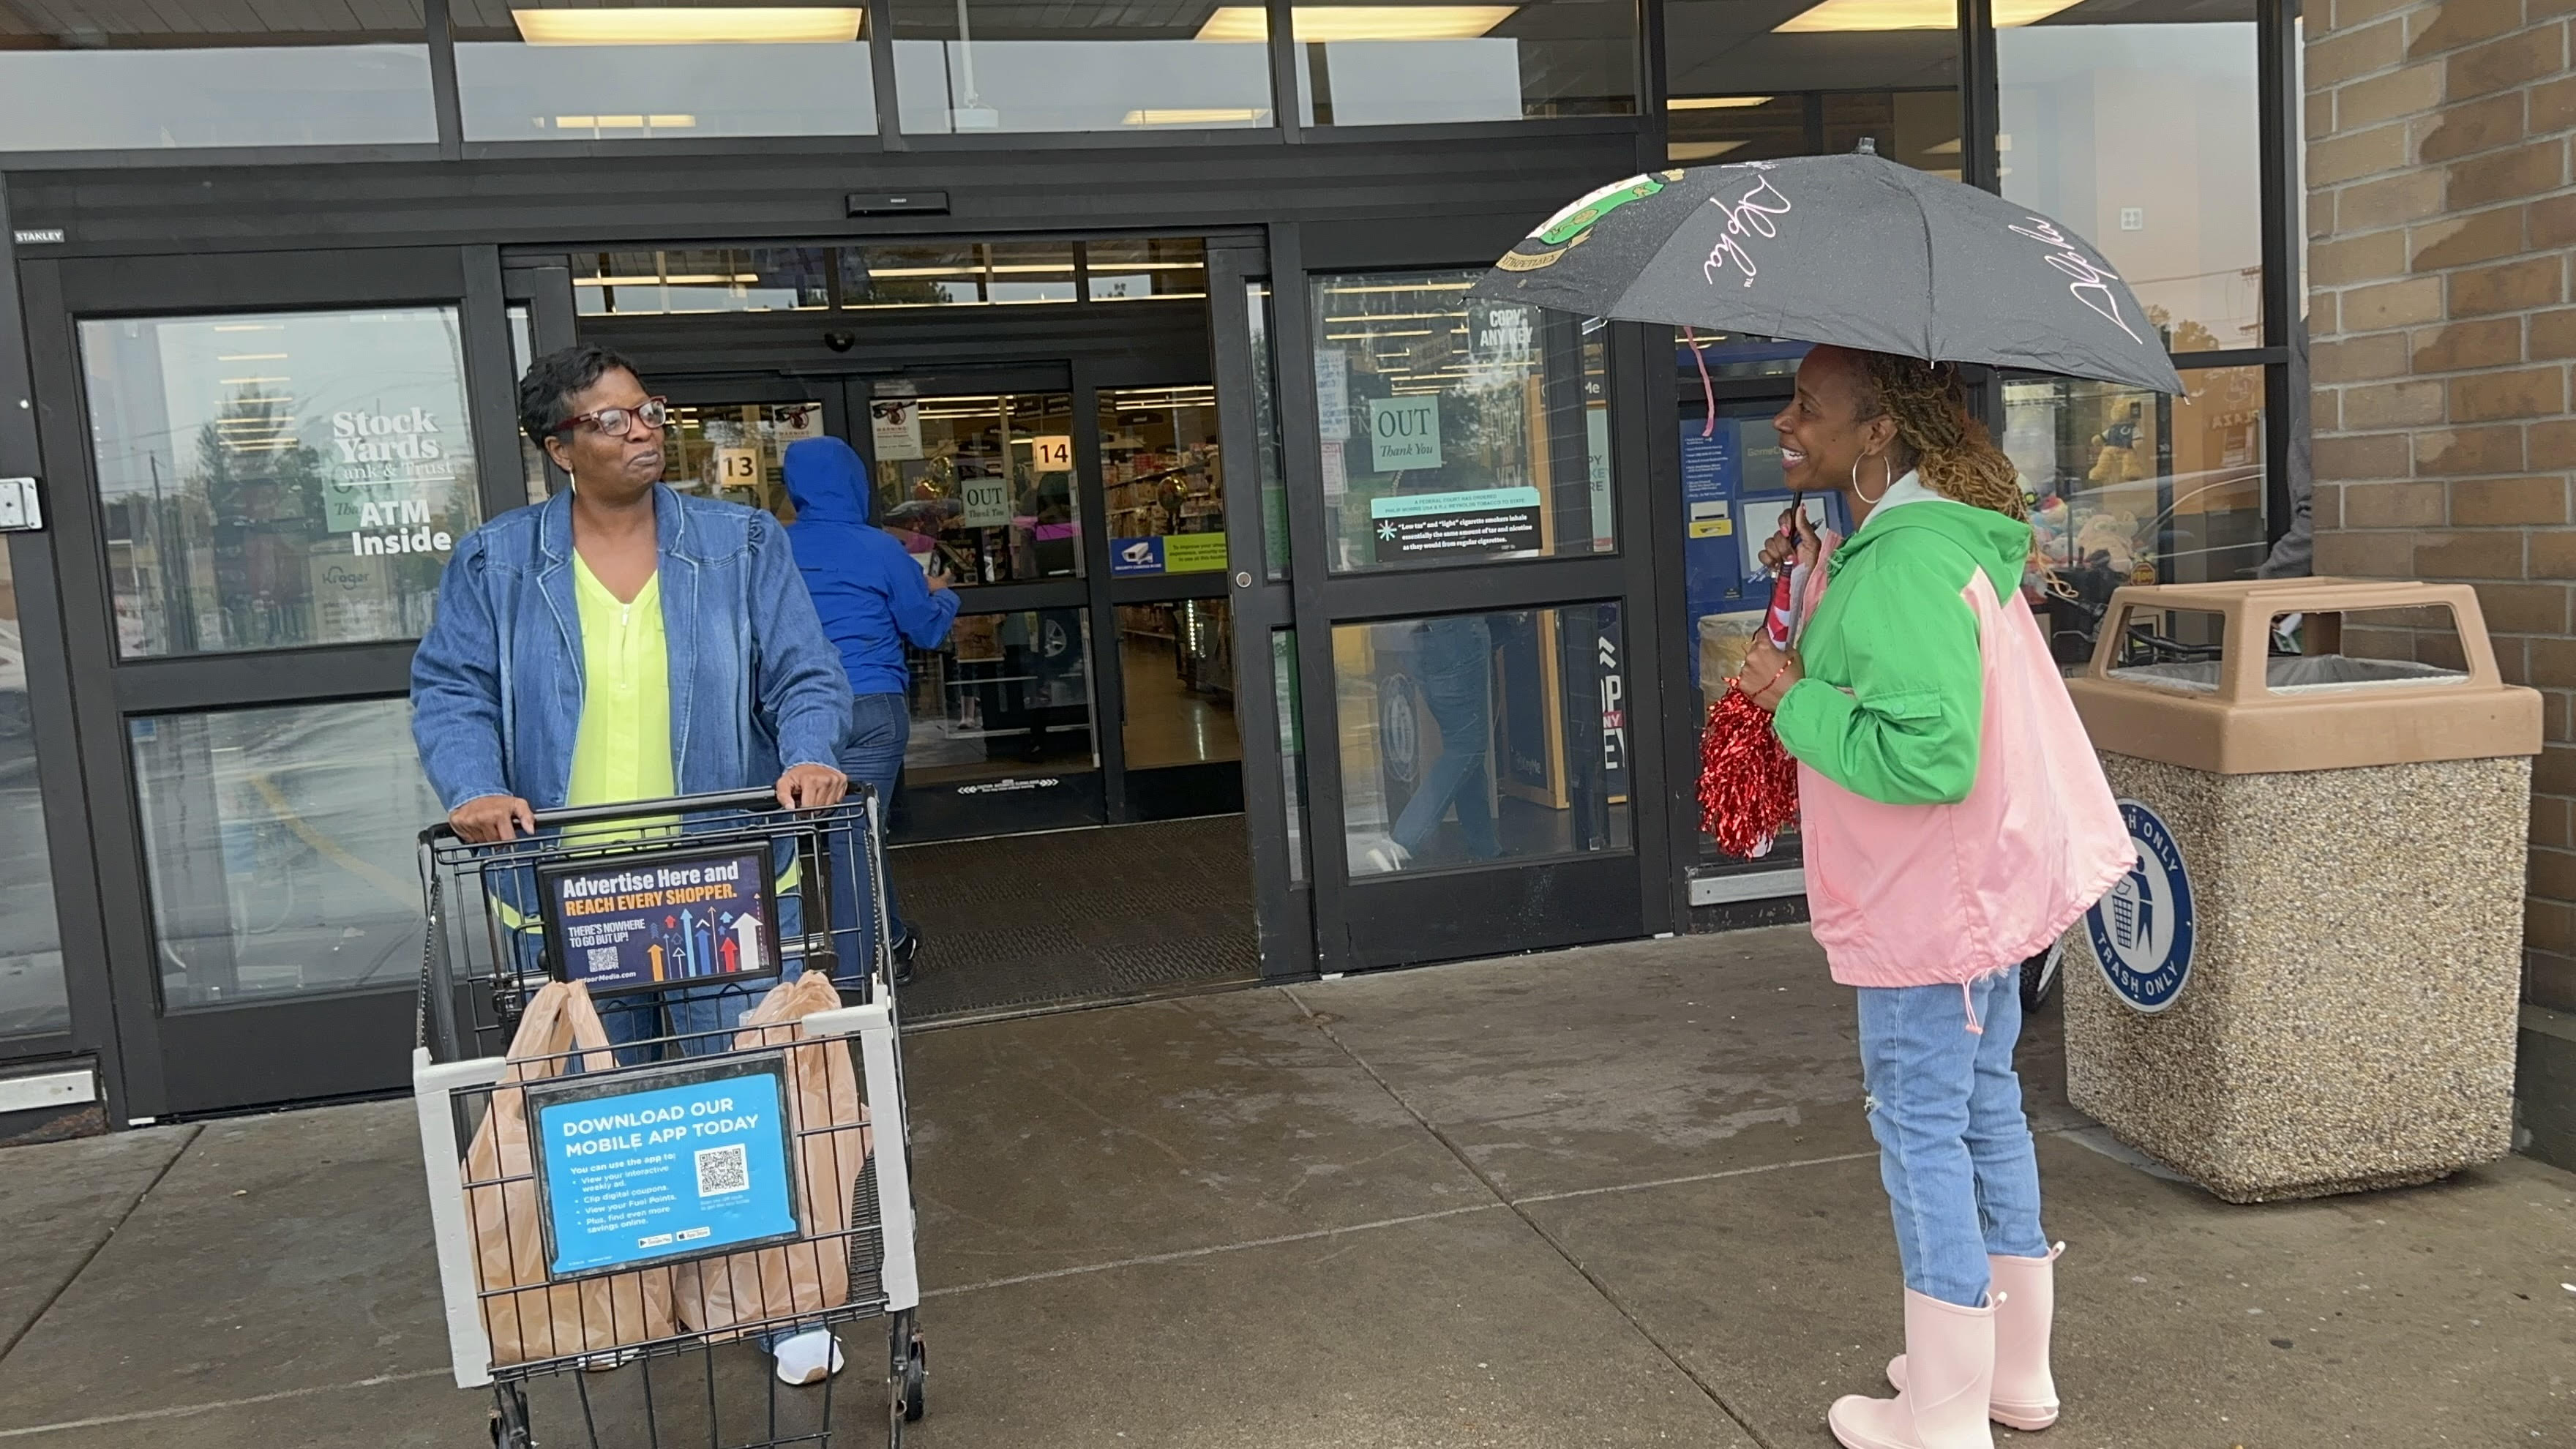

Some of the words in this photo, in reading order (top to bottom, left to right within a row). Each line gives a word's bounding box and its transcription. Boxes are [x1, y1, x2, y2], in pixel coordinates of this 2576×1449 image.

[15, 232, 61, 242] STANLEY
[1489, 308, 1521, 327] COPY
[1480, 329, 1506, 346] ANY
[1508, 326, 1533, 344] KEY
[332, 406, 442, 438] Stock
[1378, 408, 1431, 438] OUT
[334, 433, 441, 464] Yards
[1040, 443, 1068, 463] 14
[1379, 443, 1413, 457] Thank
[1415, 442, 1433, 455] You
[723, 456, 754, 476] 13
[1589, 454, 1603, 465] PY
[338, 463, 377, 480] ank
[383, 463, 397, 476] &
[404, 460, 453, 476] Trust
[967, 487, 1003, 506] OUT
[1591, 482, 1604, 492] RE
[360, 499, 431, 528] ATM
[1459, 518, 1484, 527] cigarette
[1485, 516, 1509, 524] smokers
[1509, 514, 1527, 522] inhale
[352, 525, 452, 556] Inside
[1401, 532, 1432, 540] essentially
[1509, 524, 1532, 532] nicotine
[1409, 543, 1423, 551] they
[1423, 542, 1441, 550] would
[1456, 539, 1478, 547] regular
[1478, 537, 1508, 545] cigarettes.
[2143, 821, 2179, 872] ONLY
[564, 872, 654, 899] Advertise
[657, 868, 700, 888] Here
[704, 861, 738, 883] and
[565, 896, 615, 917] REACH
[617, 890, 663, 912] EVERY
[666, 883, 738, 905] SHOPPER.
[568, 924, 602, 937] THERE'S
[603, 918, 645, 933] NOWHERE
[569, 937, 582, 948] TO
[583, 935, 595, 947] GO
[596, 933, 613, 946] BUT
[614, 932, 629, 943] UP!
[2097, 932, 2139, 993] TRASH
[2145, 960, 2179, 996] ONLY
[563, 1105, 685, 1137] DOWNLOAD
[690, 1098, 733, 1117] OUR
[566, 1134, 643, 1158] MOBILE
[648, 1126, 686, 1145] APP
[692, 1114, 759, 1137] TODAY
[571, 1167, 588, 1175] You
[590, 1164, 607, 1172] can
[609, 1161, 624, 1169] use
[626, 1158, 642, 1167] the
[644, 1155, 662, 1164] app
[581, 1176, 602, 1184] View
[604, 1173, 623, 1183] your
[625, 1165, 669, 1177] interactive
[583, 1182, 612, 1192] weekly
[614, 1179, 626, 1188] ad.
[583, 1195, 601, 1204] Clip
[602, 1190, 629, 1201] digital
[631, 1184, 669, 1197] coupons.
[585, 1205, 605, 1214] View
[607, 1202, 626, 1213] your
[629, 1198, 647, 1208] Fuel
[649, 1194, 677, 1204] Points.
[586, 1216, 607, 1226] Plus,
[608, 1213, 625, 1222] find
[626, 1210, 647, 1219] even
[648, 1206, 670, 1215] more
[587, 1222, 619, 1234] savings
[621, 1218, 649, 1228] online.
